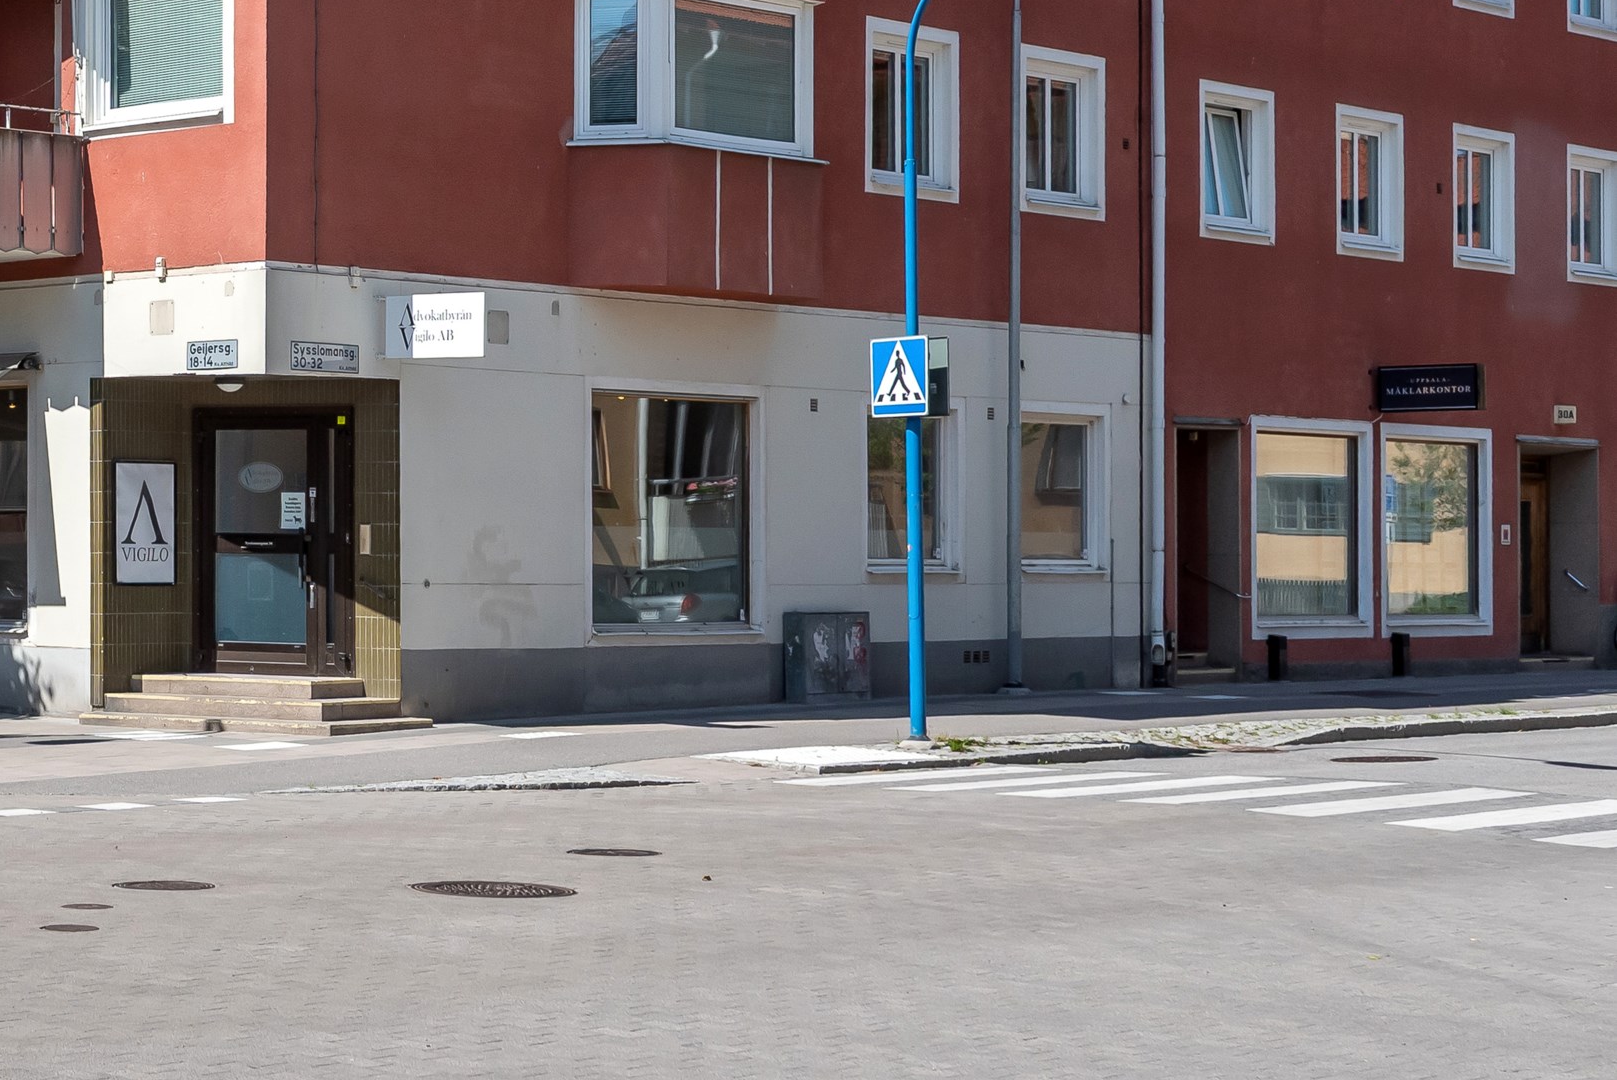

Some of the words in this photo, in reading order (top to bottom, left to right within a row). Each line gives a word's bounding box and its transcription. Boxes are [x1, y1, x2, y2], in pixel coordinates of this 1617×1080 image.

[399, 327, 435, 351] Vigilo
[437, 329, 454, 341] AB
[189, 343, 234, 357] Geijersg.
[293, 343, 357, 361] Sysslomansg.
[293, 357, 323, 369] 30-32
[1386, 385, 1471, 395] MÄKLARKONTOR
[1557, 410, 1575, 419] 30A
[121, 546, 169, 563] VIGILO
